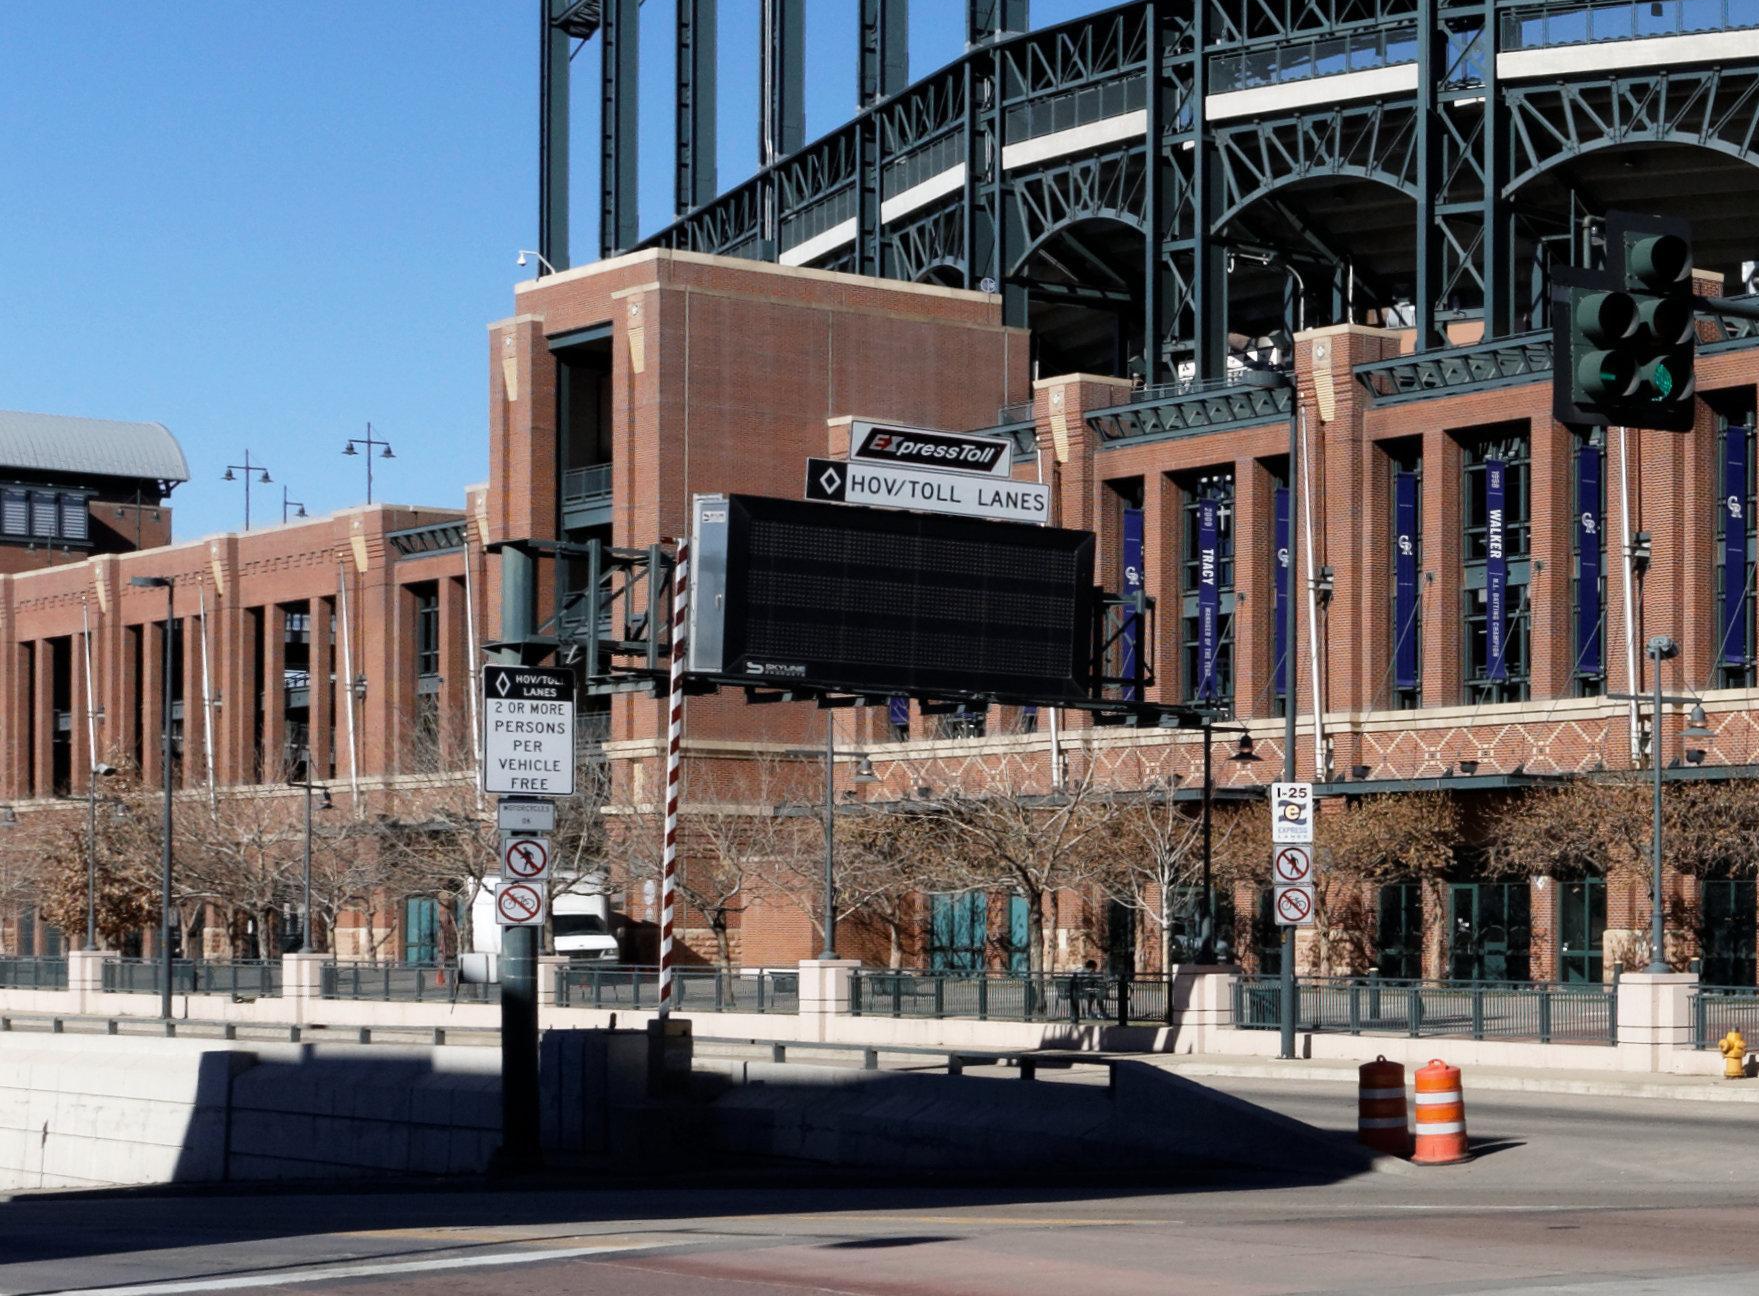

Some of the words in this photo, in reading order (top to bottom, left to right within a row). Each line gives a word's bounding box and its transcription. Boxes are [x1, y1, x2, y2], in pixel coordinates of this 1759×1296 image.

[851, 474, 961, 503] HOV/TOLL
[978, 489, 1045, 512] LANES
[1489, 509, 1502, 559] WALKER
[1202, 549, 1215, 585] TRACY
[523, 688, 557, 697] LANES
[495, 702, 502, 713] 2
[508, 702, 525, 714] OR
[530, 703, 565, 715] MORE
[495, 720, 565, 734] PERSONS
[513, 740, 542, 752] PER
[499, 759, 561, 772] VEHICLE
[511, 778, 548, 790] FREE
[1277, 787, 1307, 798] I-25
